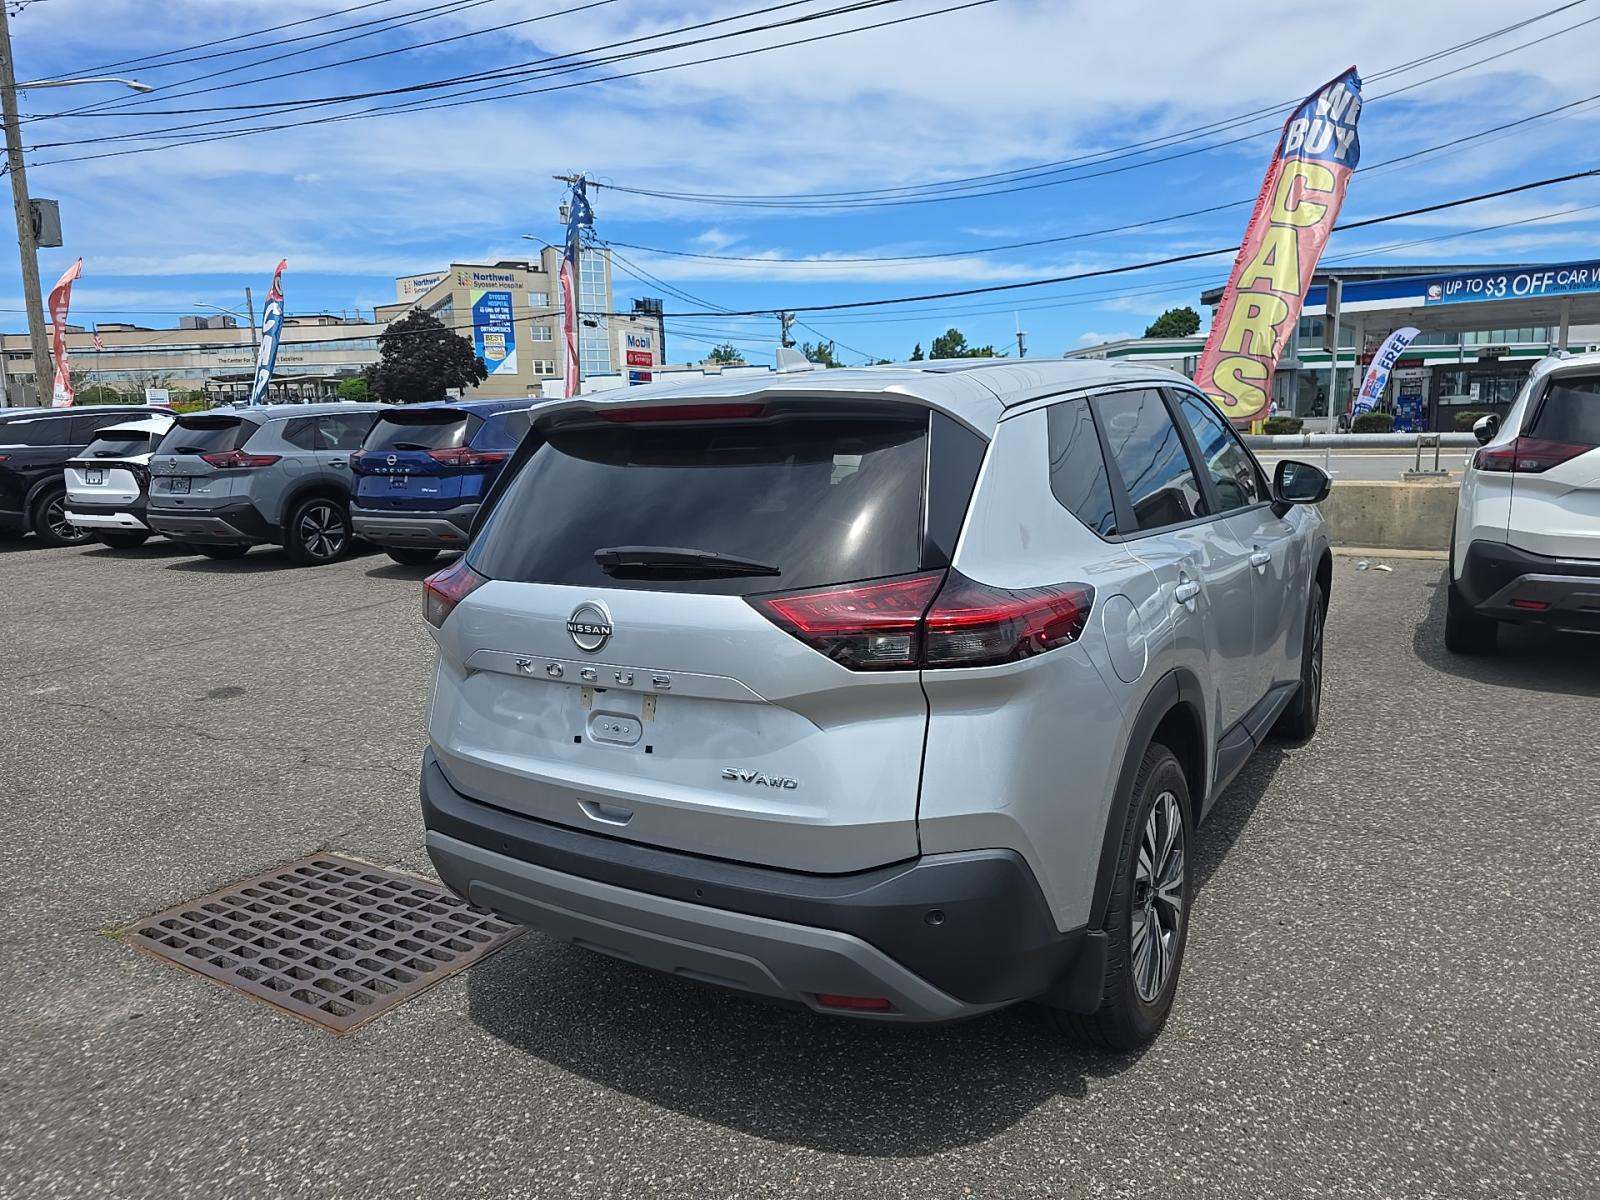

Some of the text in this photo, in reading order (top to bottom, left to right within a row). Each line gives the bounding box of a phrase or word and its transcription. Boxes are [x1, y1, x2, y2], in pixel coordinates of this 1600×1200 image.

[1286, 118, 1355, 161] BUY
[473, 272, 514, 282] Northwell
[1203, 159, 1335, 419] CARS
[1446, 281, 1462, 295] UP
[1466, 278, 1483, 293] TO
[1485, 276, 1507, 297] $3
[1512, 271, 1554, 296] OFF
[1557, 269, 1588, 285] CAR
[627, 335, 650, 349] Mobil
[1381, 334, 1409, 370] FREE
[567, 622, 610, 635] NISSAN
[516, 658, 671, 689] ROGUE
